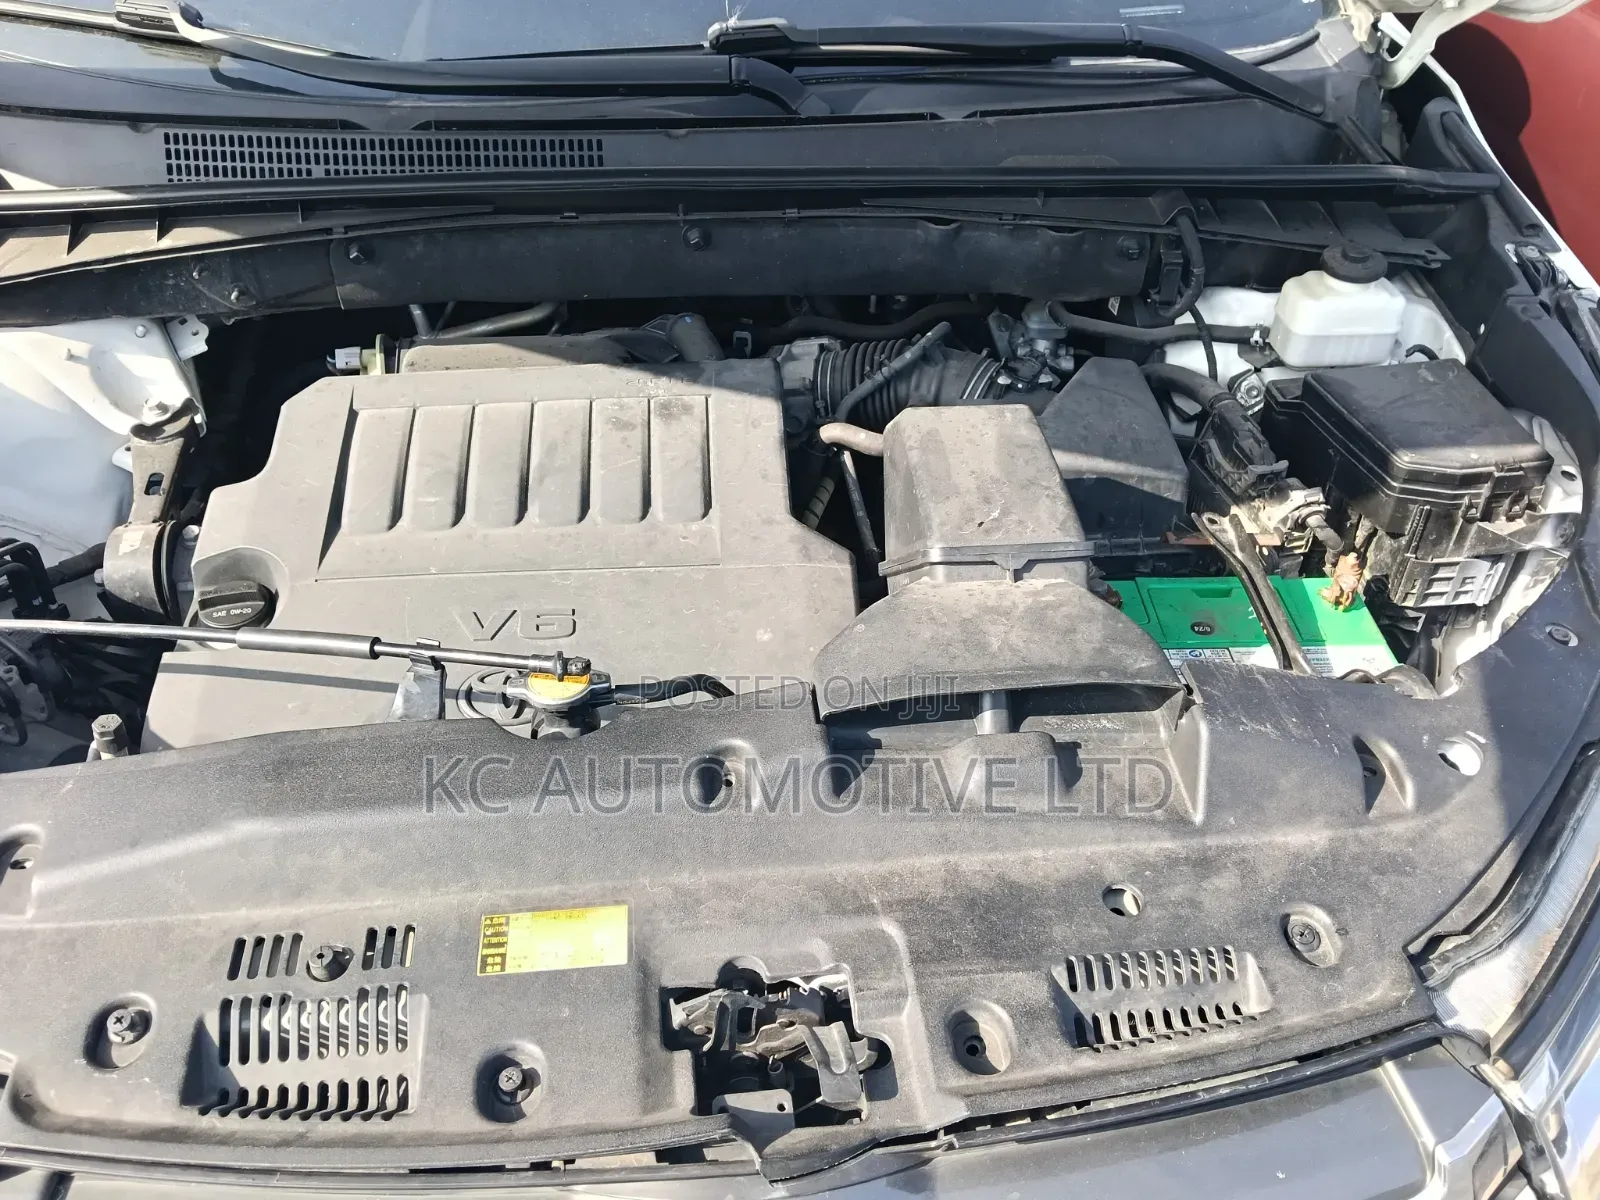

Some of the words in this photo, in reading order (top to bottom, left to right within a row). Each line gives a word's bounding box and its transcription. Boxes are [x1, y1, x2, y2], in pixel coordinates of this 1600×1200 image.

[212, 610, 227, 618] SAE
[230, 607, 252, 615] 0W-20
[452, 607, 577, 642] V6
[484, 925, 509, 933] CAUTION
[483, 936, 508, 944] ATTENTION
